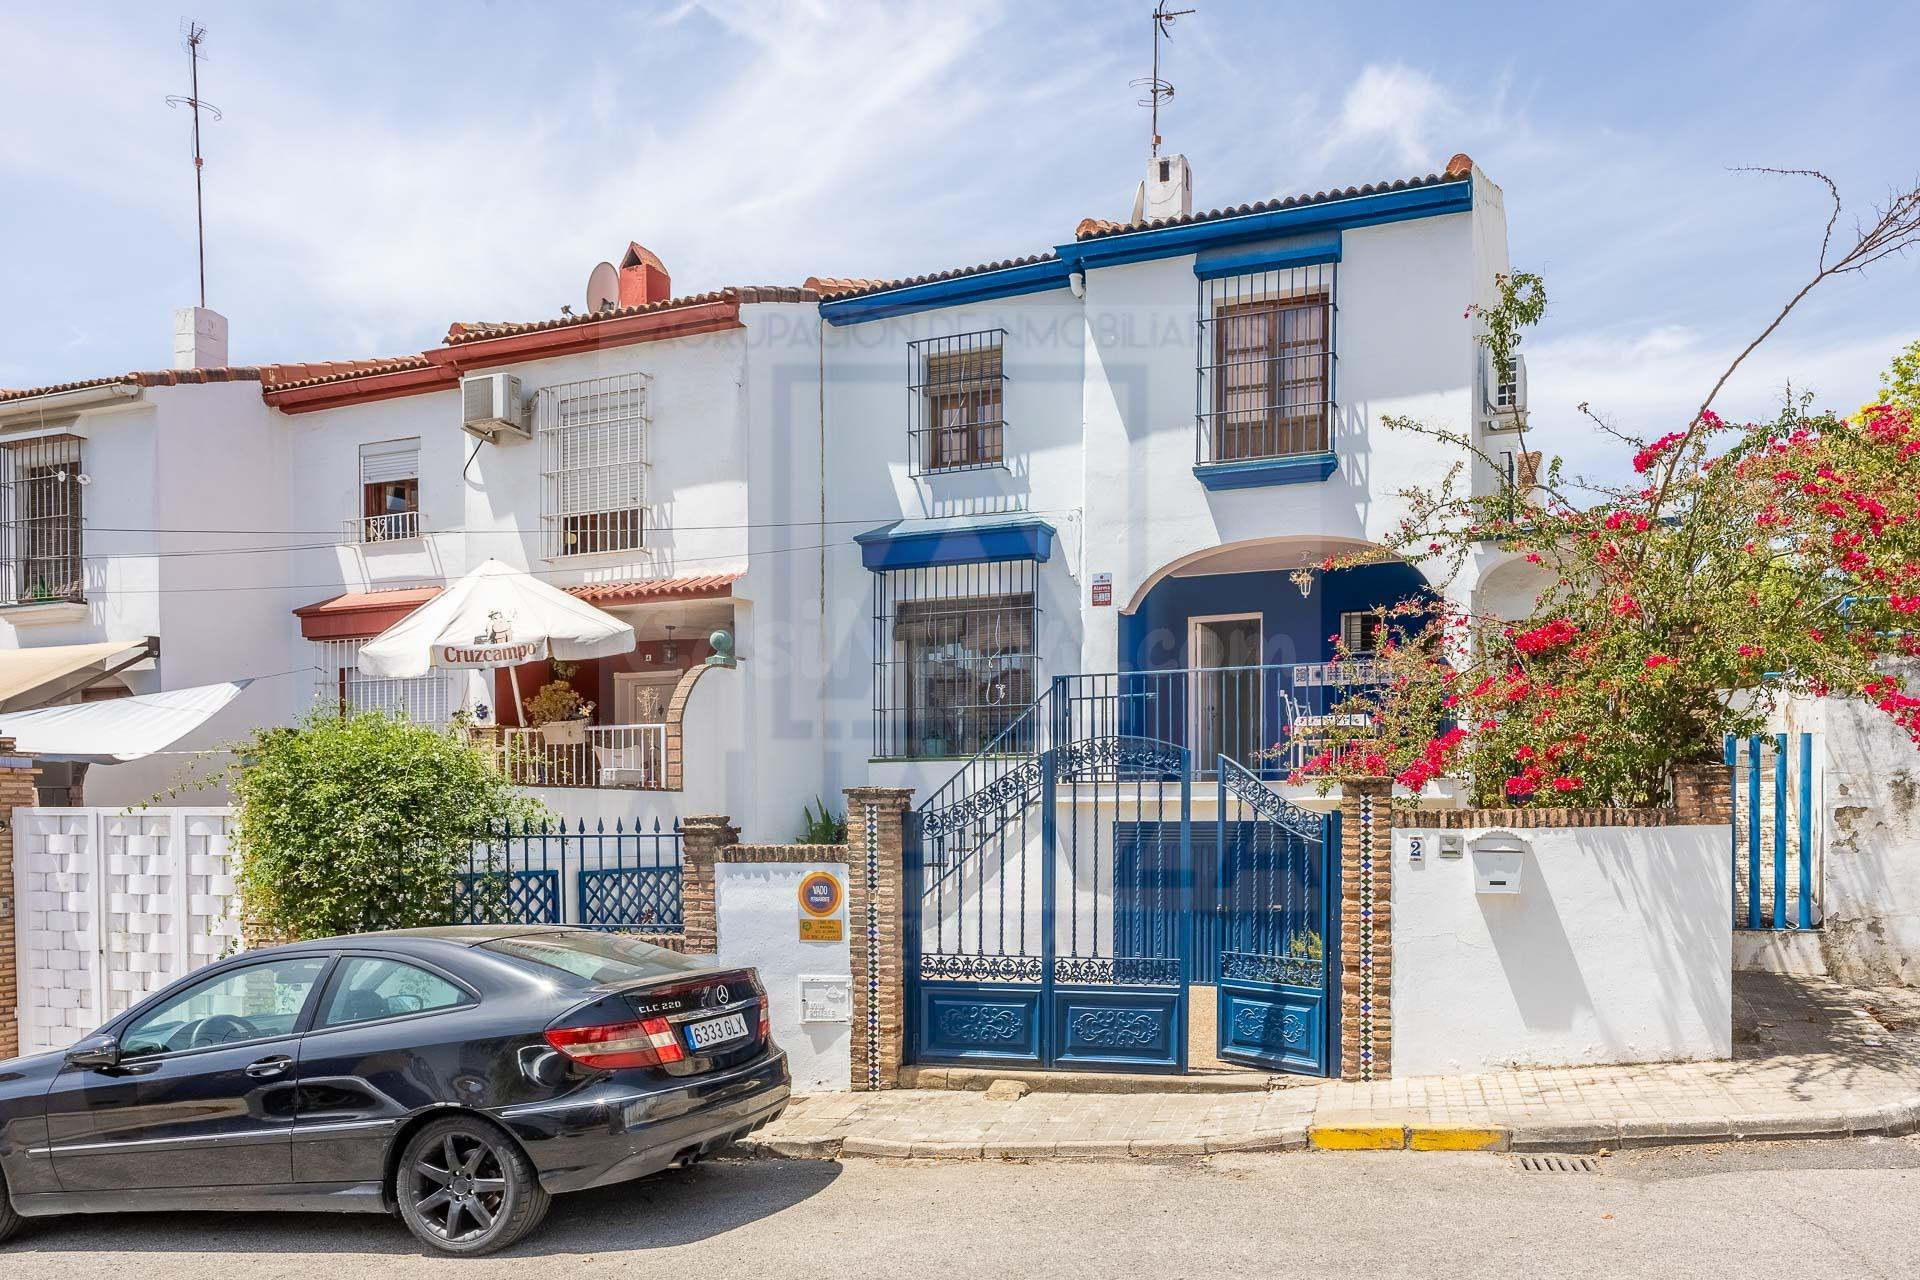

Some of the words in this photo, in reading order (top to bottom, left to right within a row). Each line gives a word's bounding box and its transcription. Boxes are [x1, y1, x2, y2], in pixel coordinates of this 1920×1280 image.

[443, 643, 537, 663] Cruzcampo
[1411, 841, 1421, 856] 2
[812, 885, 828, 895] VADO
[638, 1005, 660, 1014] CLC
[662, 1000, 682, 1010] 220
[694, 1022, 724, 1044] 6333
[724, 1016, 746, 1036] GLX
